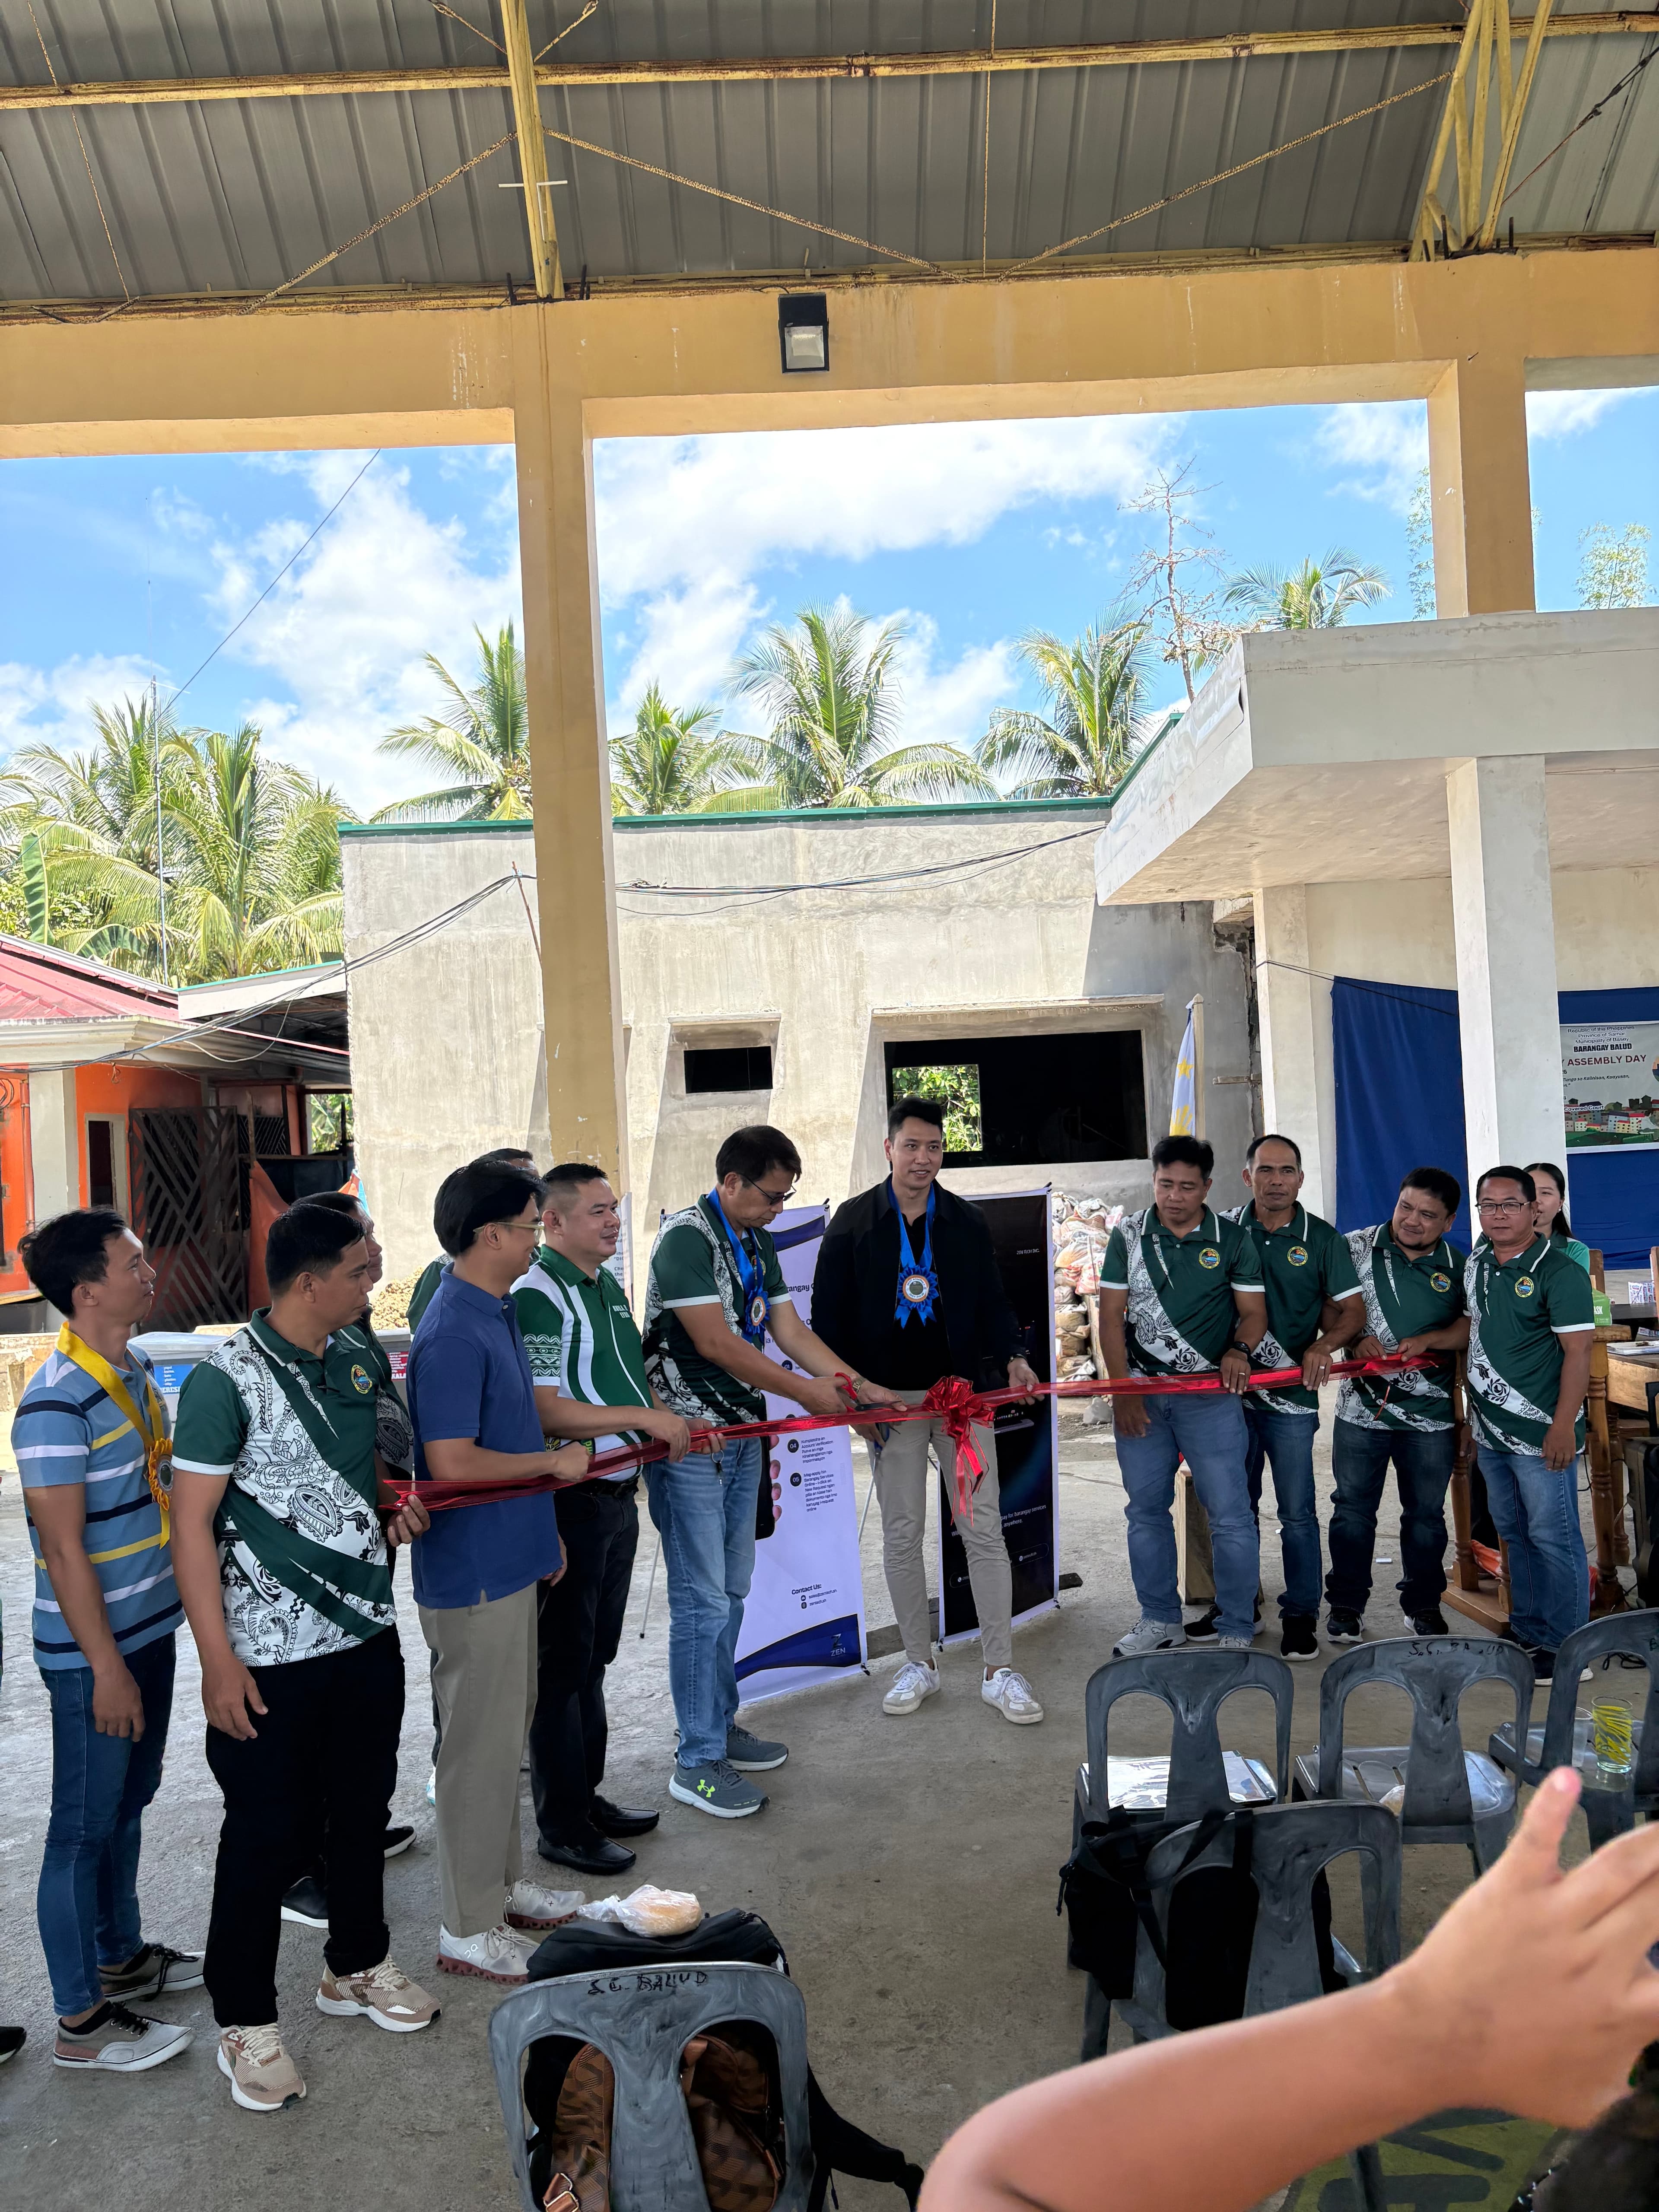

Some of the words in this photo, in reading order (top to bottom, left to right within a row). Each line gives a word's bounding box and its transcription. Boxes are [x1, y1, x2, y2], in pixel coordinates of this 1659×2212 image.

[1573, 1044, 1609, 1052] BARANGAY
[1567, 1056, 1622, 1066] ASSEMBLY
[1626, 1055, 1646, 1063] DAY
[791, 1586, 813, 1595] Contact
[830, 1647, 846, 1656] ZEN
